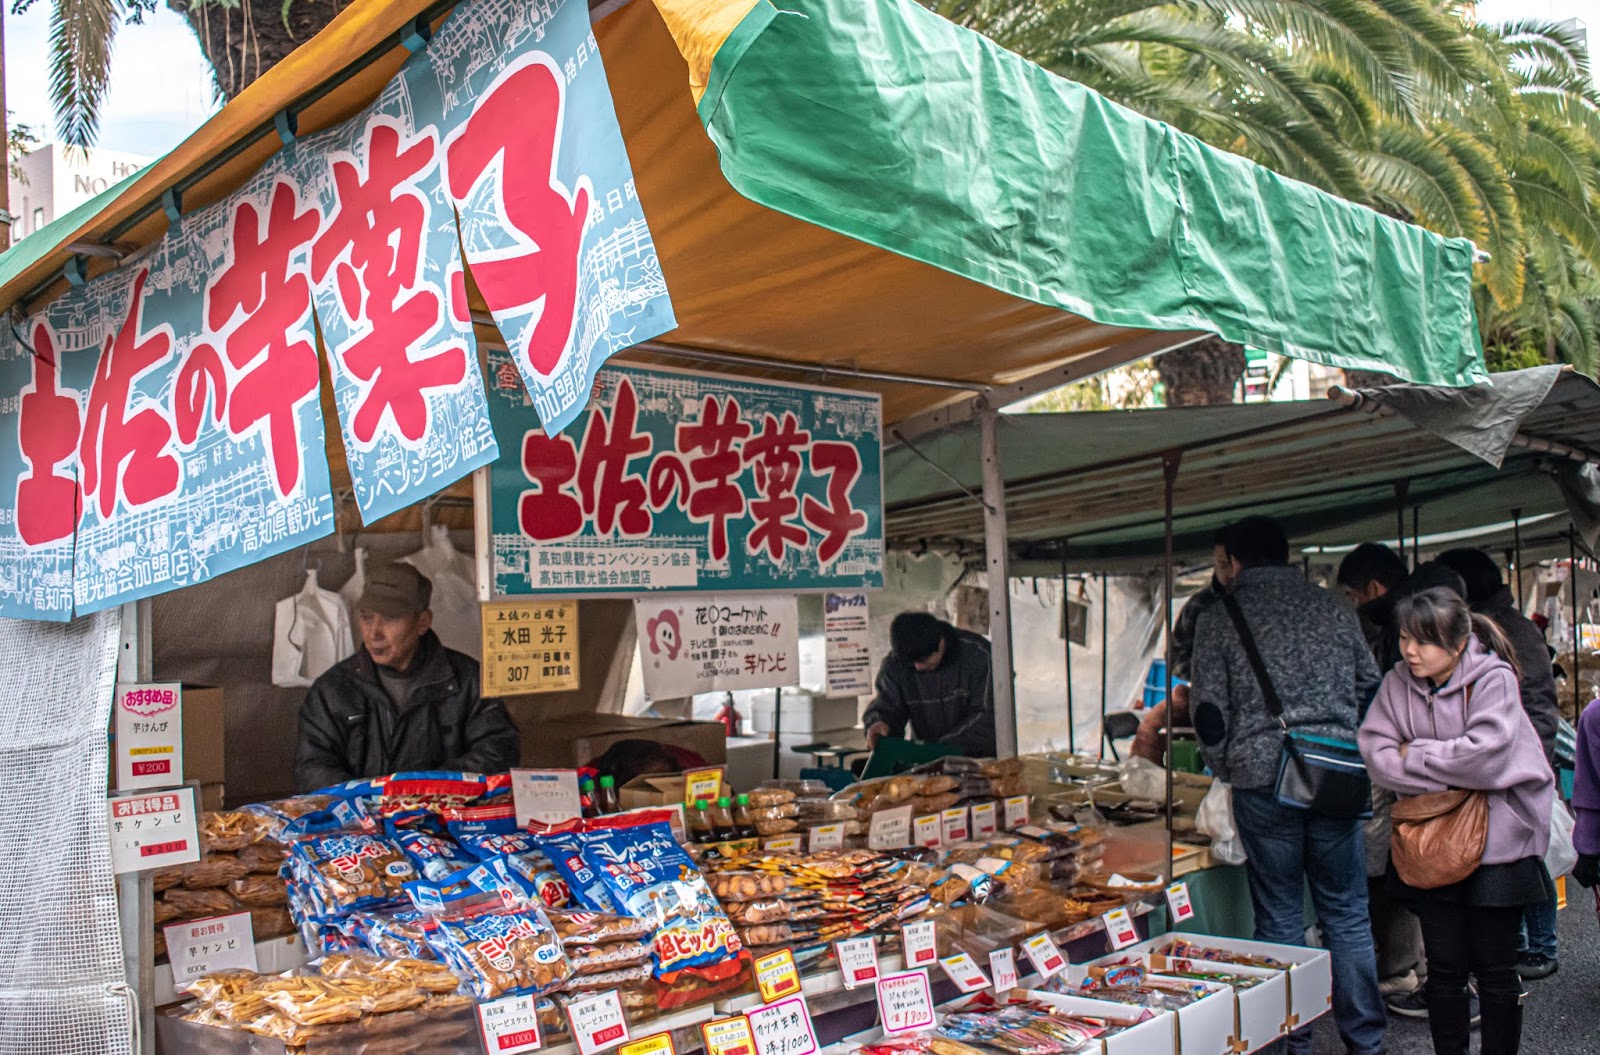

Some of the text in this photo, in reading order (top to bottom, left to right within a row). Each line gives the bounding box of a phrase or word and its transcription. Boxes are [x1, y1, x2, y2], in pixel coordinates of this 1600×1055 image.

[16, 55, 590, 547] 土佐の芋菓子
[519, 377, 868, 567] 土佐の芋菓子
[33, 548, 190, 612] 高知市観光協会加盟店
[535, 361, 587, 426] 加盟店
[538, 549, 691, 567] 高知県観光コンベンション協会
[539, 568, 652, 586] 高知市観光協会加盟店
[497, 608, 566, 621] 土佐の日曜市
[503, 625, 567, 646] 水田 光子
[507, 666, 529, 682] 307
[126, 689, 173, 707] おすすめ品
[138, 761, 165, 774] ¥200
[118, 796, 176, 816] お買得品
[503, 1032, 533, 1047] ¥1000
